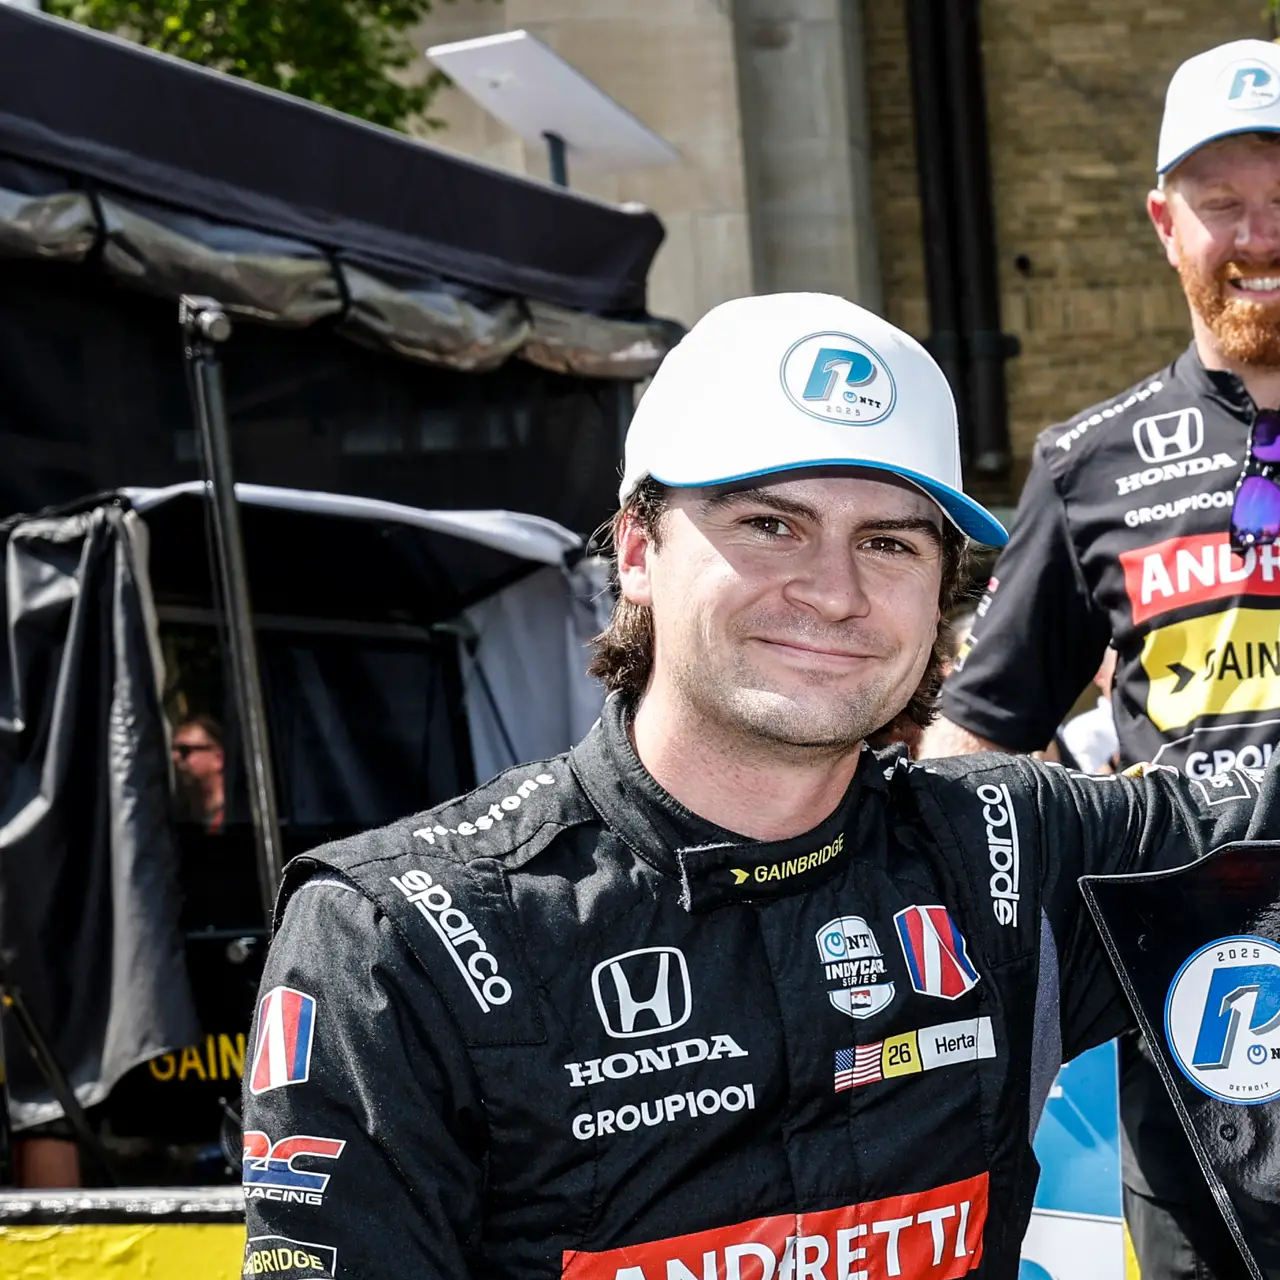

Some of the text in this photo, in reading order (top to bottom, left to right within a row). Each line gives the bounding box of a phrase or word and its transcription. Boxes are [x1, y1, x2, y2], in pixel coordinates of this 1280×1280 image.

[1115, 452, 1237, 496] HONDA
[1124, 490, 1235, 528] GROUP1001
[753, 832, 846, 885] GAINBRIDGE
[980, 783, 1020, 928] sparco
[389, 868, 514, 1015] sparco
[1216, 948, 1261, 962] 2025
[825, 957, 887, 981] INDYCAR
[842, 973, 878, 987] SERIES
[564, 1033, 750, 1088] HONDA
[888, 1033, 976, 1067] 26 Herta
[1229, 1081, 1270, 1093] DETROIT
[572, 1083, 756, 1141] GROUP1001
